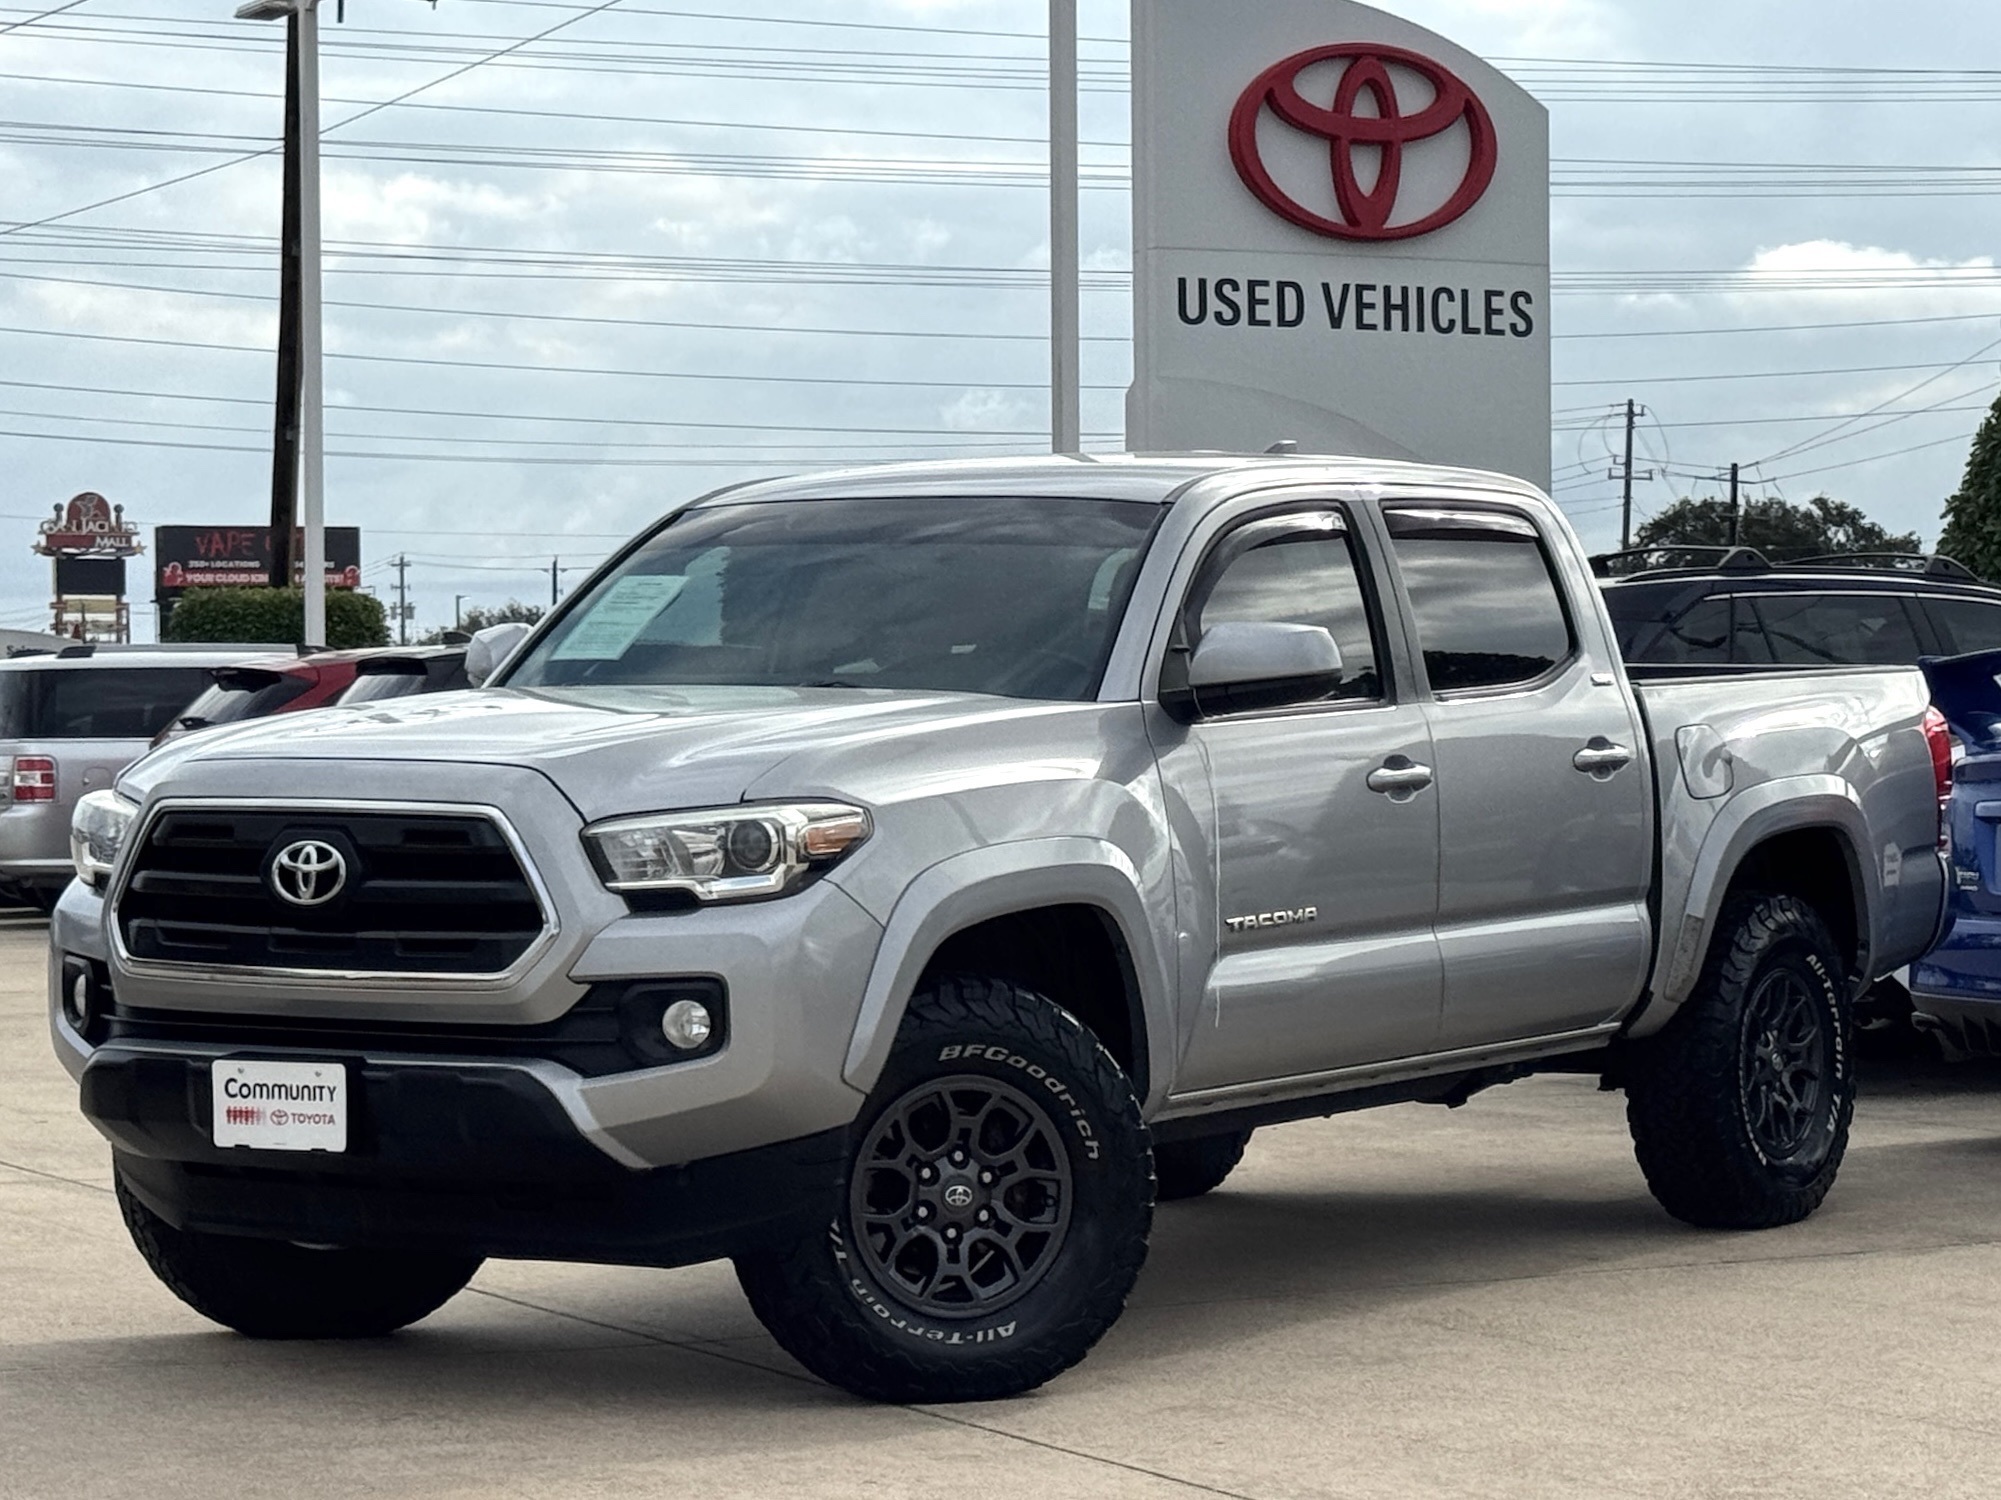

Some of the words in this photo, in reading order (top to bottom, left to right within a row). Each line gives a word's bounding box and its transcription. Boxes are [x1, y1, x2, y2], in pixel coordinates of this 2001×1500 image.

[1177, 277, 1304, 328] USED
[1321, 282, 1534, 337] VEHICLES
[95, 536, 129, 547] MALL
[196, 531, 255, 557] VAPE
[210, 561, 260, 569] LOCATIONS
[186, 573, 214, 583] YOUR
[216, 573, 250, 583] CLOUD
[1225, 906, 1317, 931] TACOMA
[1806, 954, 1843, 1080] All-Terrain
[938, 1044, 1100, 1160] BFGoodrich
[290, 1113, 336, 1125] TOYOTA
[851, 1279, 1017, 1344] All-Terrain
